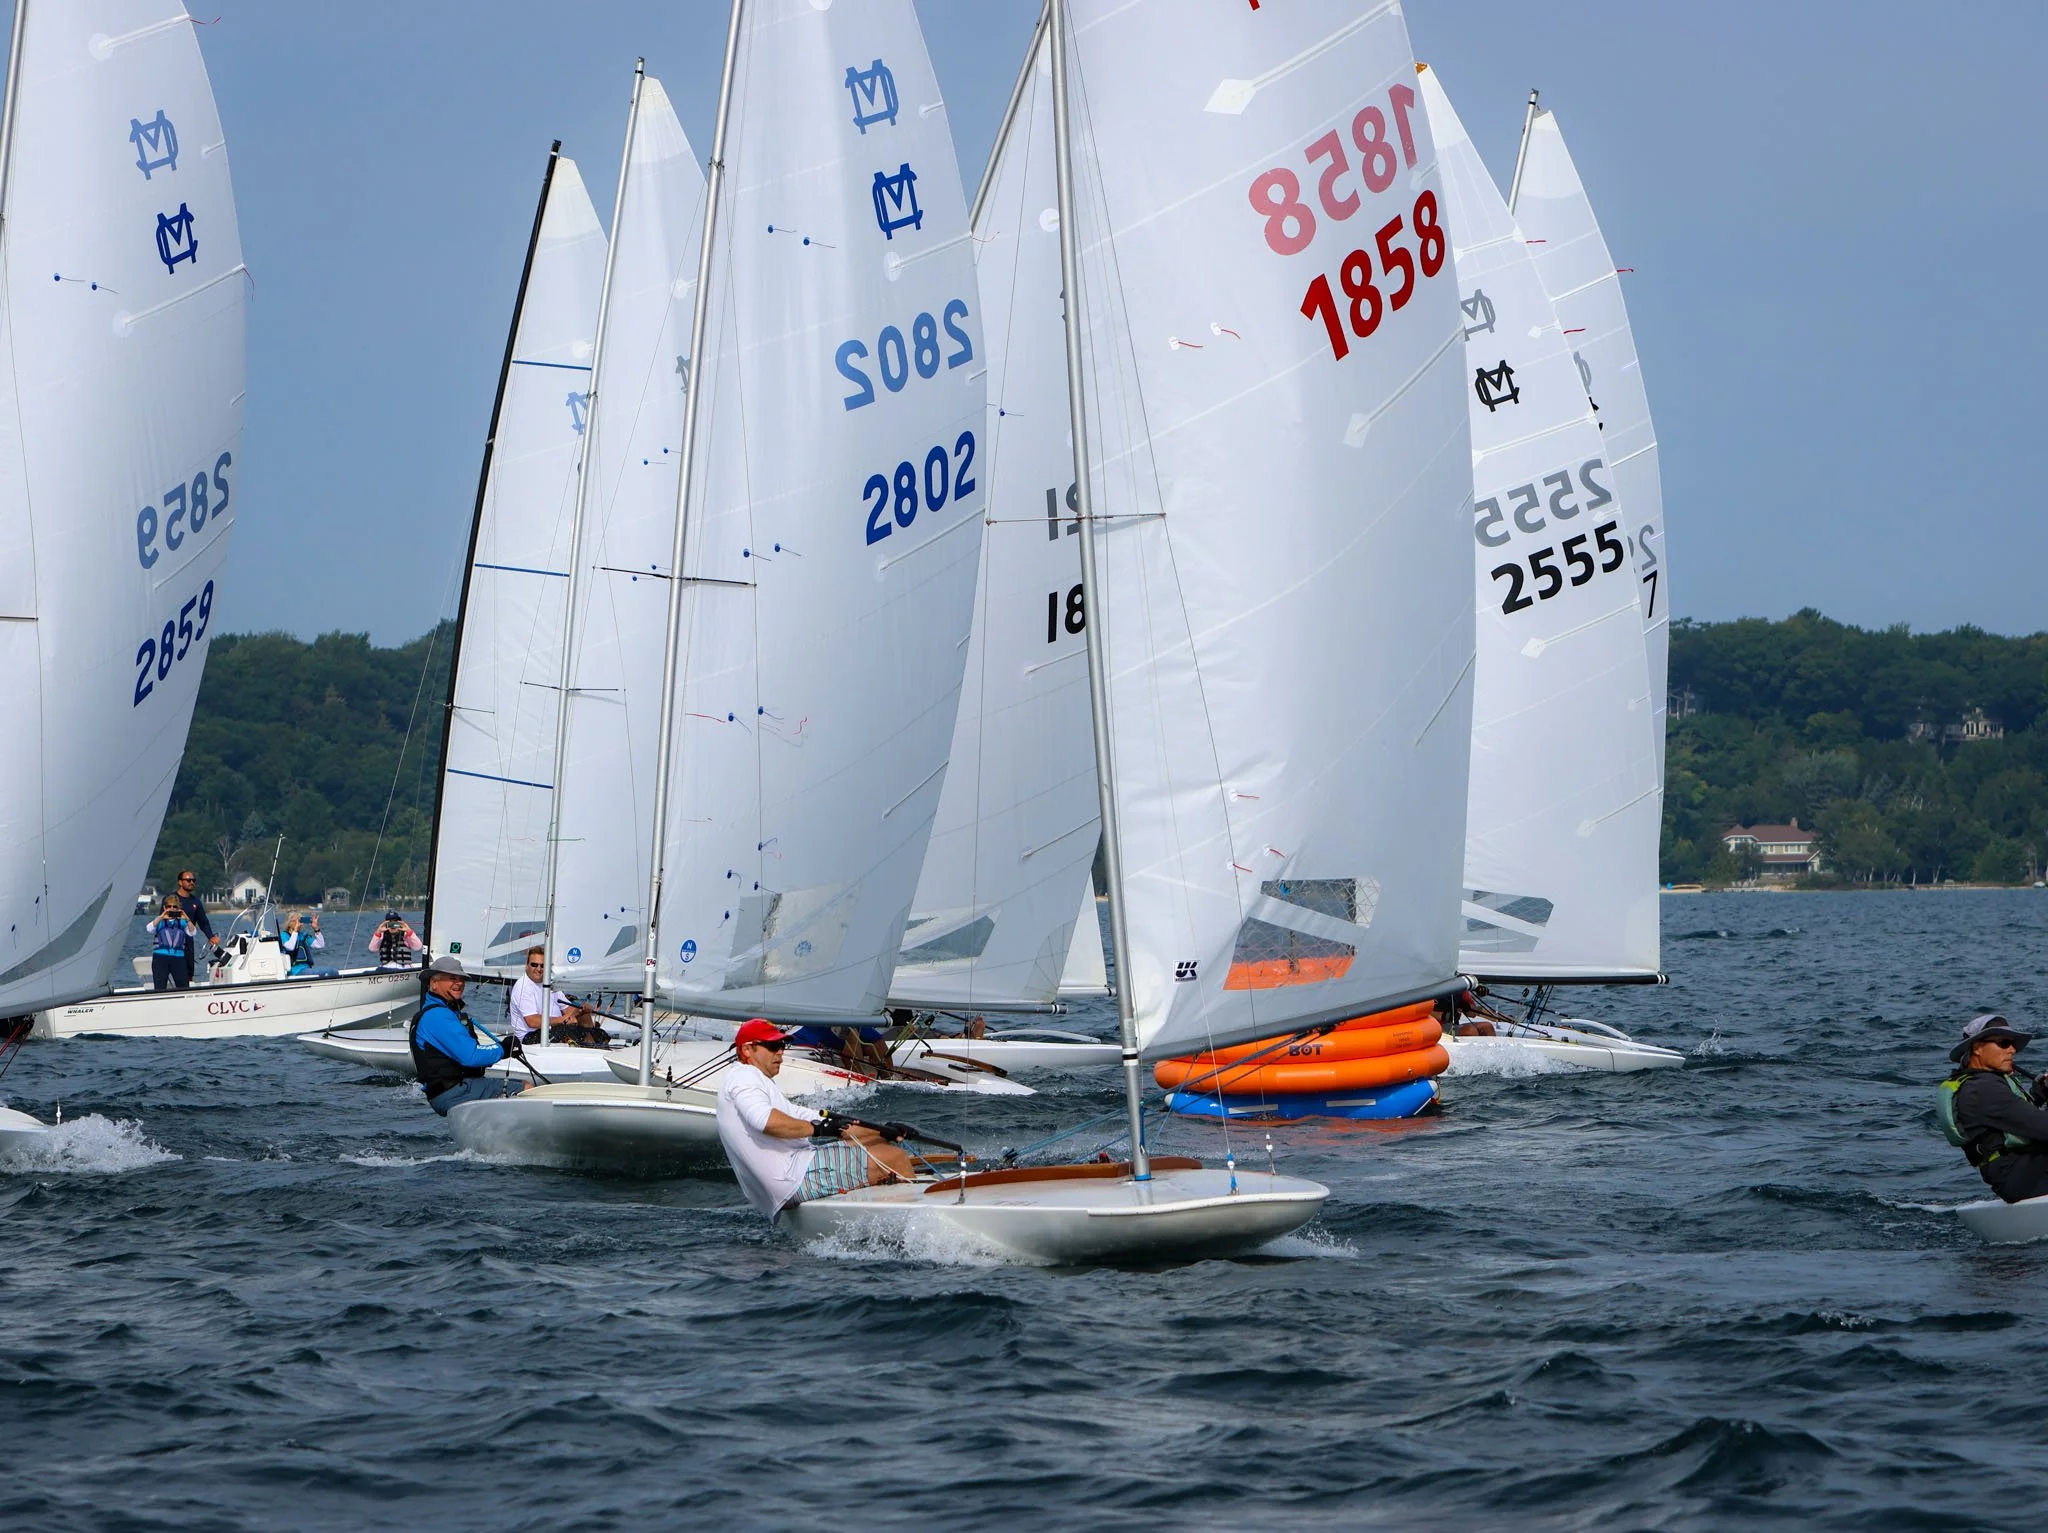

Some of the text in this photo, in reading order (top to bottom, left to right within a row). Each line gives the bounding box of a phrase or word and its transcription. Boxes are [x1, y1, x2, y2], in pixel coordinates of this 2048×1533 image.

[1300, 190, 1446, 361] 1858
[863, 430, 976, 546] 2802
[1491, 520, 1624, 615] 2555
[134, 580, 214, 708] 2859
[207, 999, 250, 1015] CLYC
[1289, 1044, 1323, 1056] BOT
